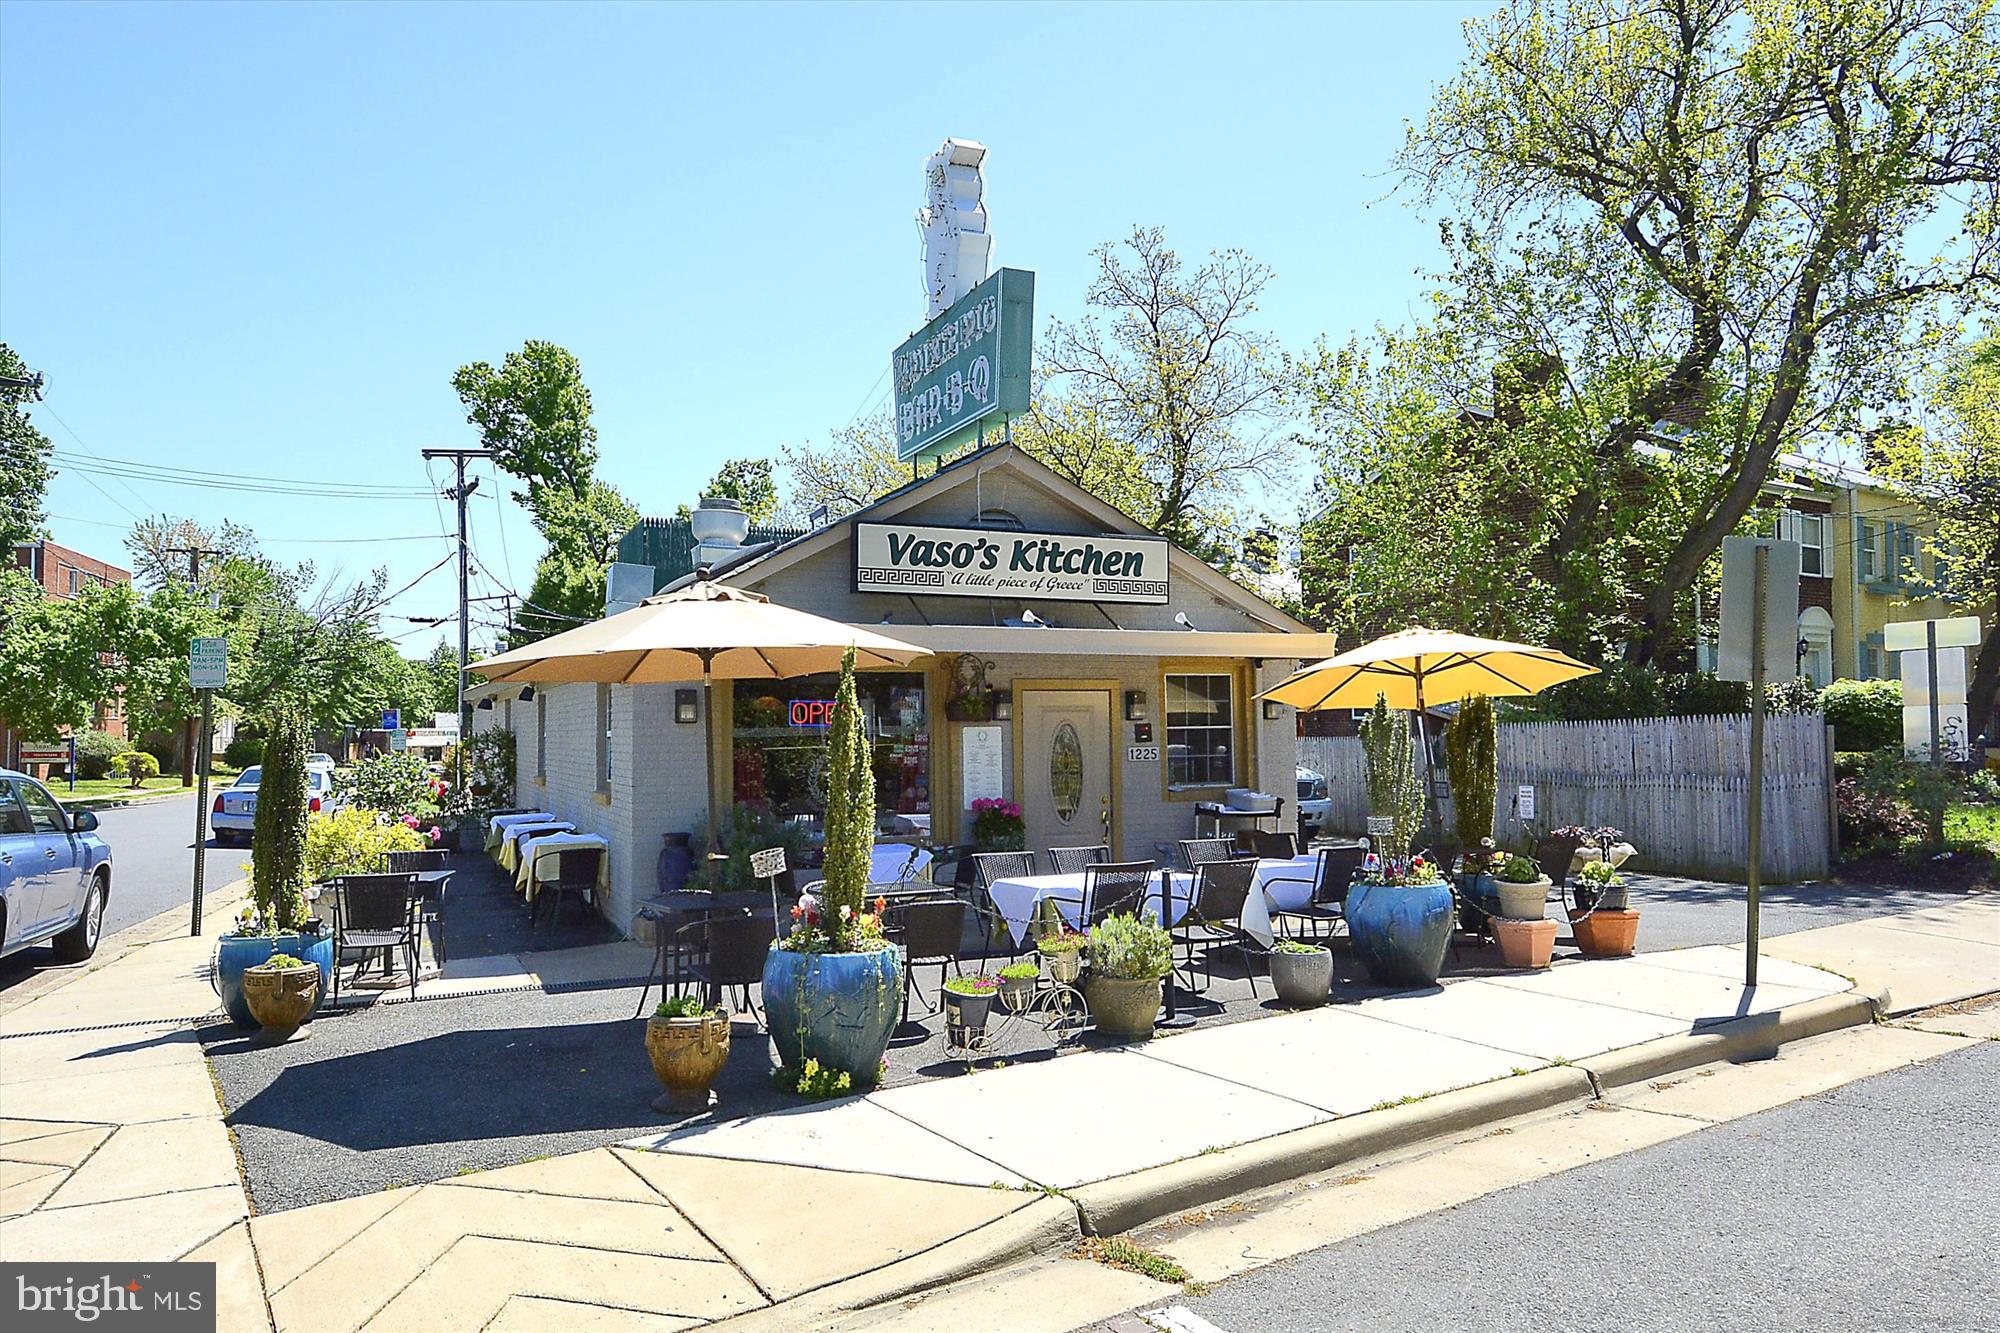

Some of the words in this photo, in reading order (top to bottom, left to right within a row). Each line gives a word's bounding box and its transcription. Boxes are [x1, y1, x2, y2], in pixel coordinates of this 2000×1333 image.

[899, 355, 990, 442] BAR-B-Q
[887, 533, 1001, 570] Vaso's
[1009, 539, 1144, 577] Kitchen
[965, 573, 995, 587] little
[995, 576, 1028, 590] piece
[1029, 577, 1046, 591] of
[192, 643, 200, 654] 2
[792, 702, 848, 724] OPE
[1130, 748, 1158, 760] 1225
